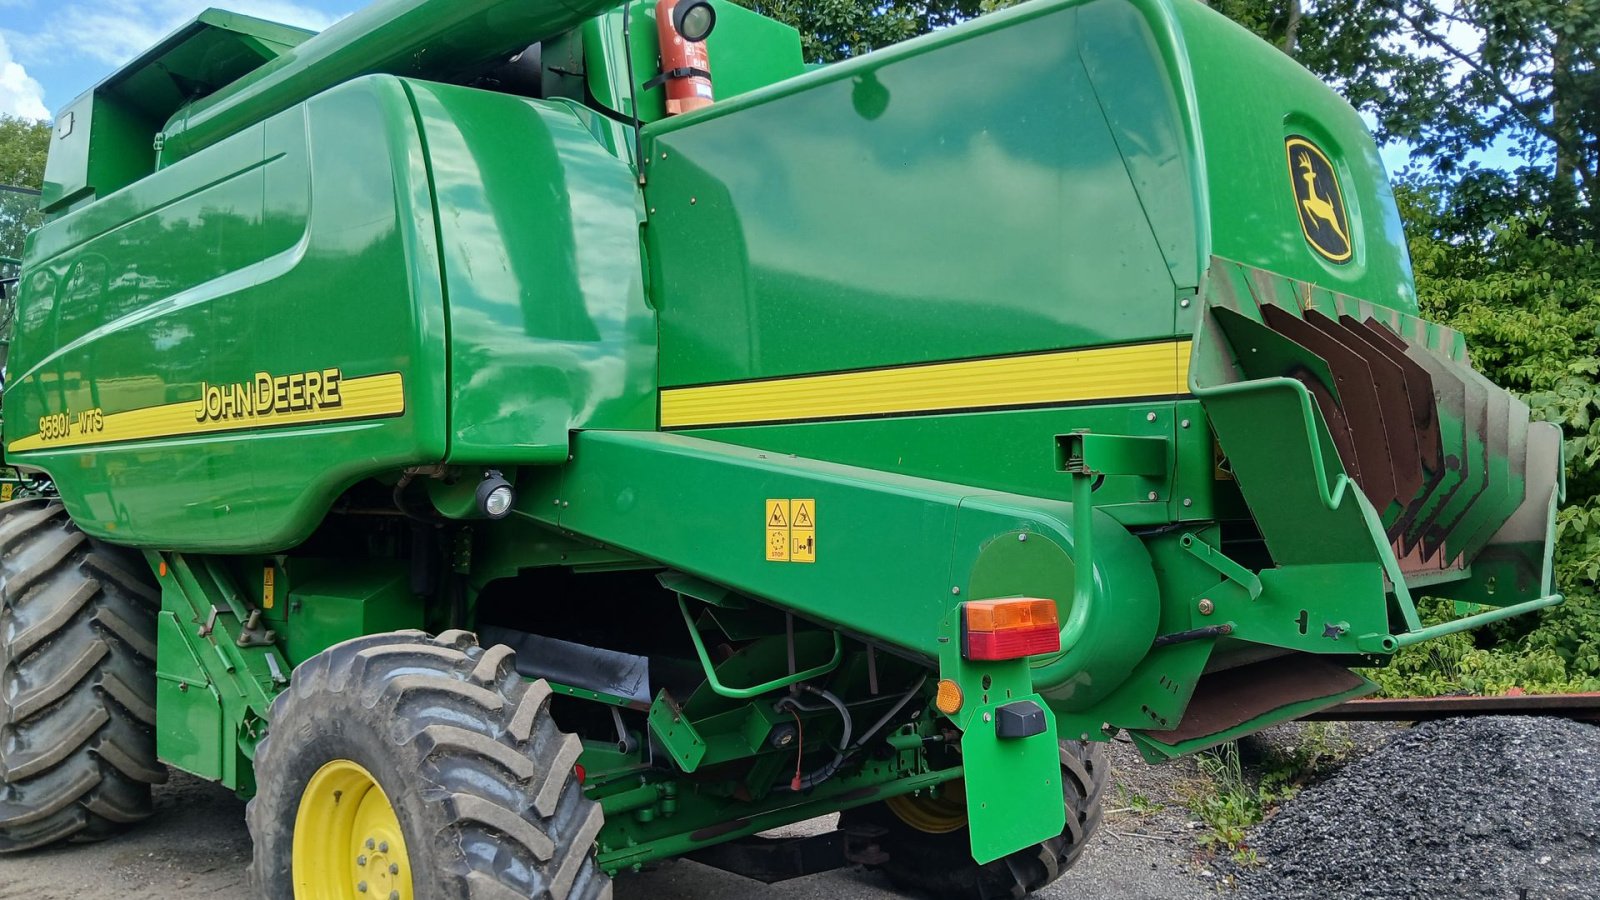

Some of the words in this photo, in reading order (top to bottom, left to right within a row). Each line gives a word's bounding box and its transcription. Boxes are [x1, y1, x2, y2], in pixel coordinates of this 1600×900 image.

[195, 381, 254, 422] JOHN
[254, 367, 342, 415] DEERE
[39, 408, 71, 440] 9580i
[78, 408, 104, 433] WTS
